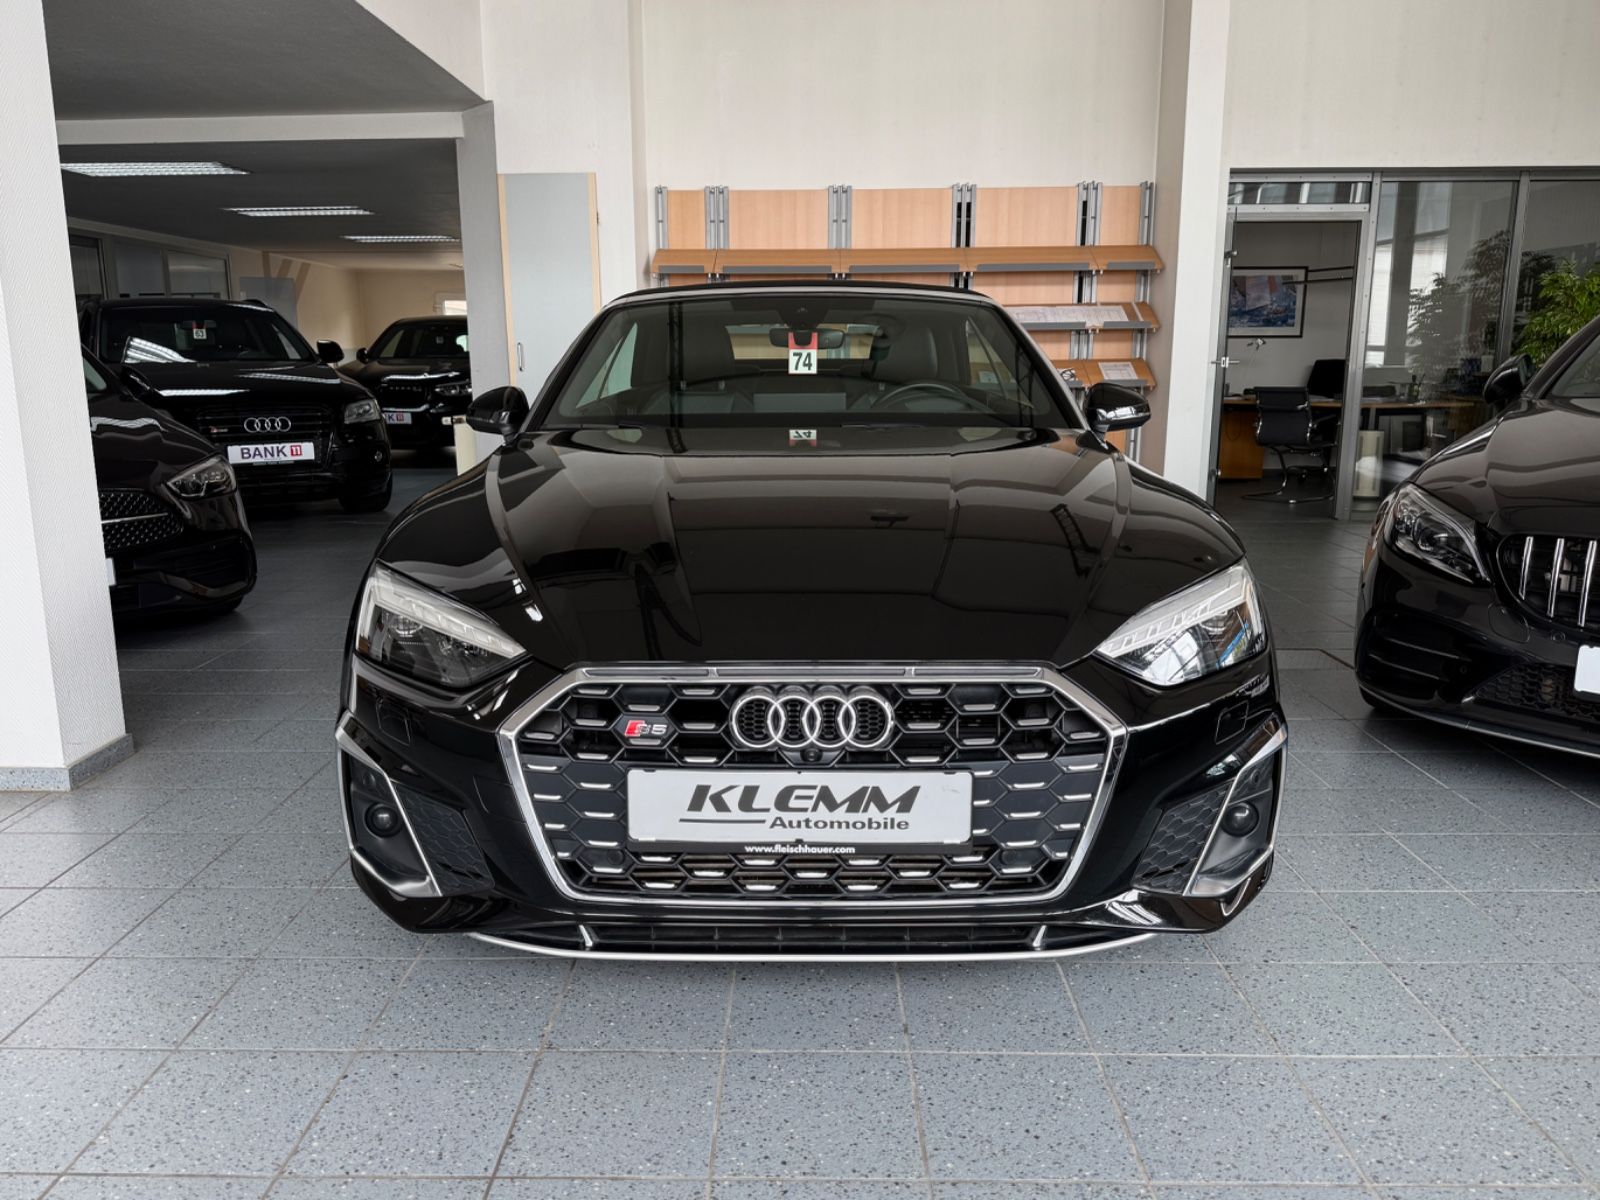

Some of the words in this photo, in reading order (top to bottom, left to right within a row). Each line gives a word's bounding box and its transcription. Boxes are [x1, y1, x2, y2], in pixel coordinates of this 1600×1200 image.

[792, 352, 812, 371] 74
[240, 445, 287, 459] BANK
[687, 784, 921, 813] KLEMM
[769, 817, 909, 830] Automobile
[744, 844, 856, 854] www.fleischhauer.com
